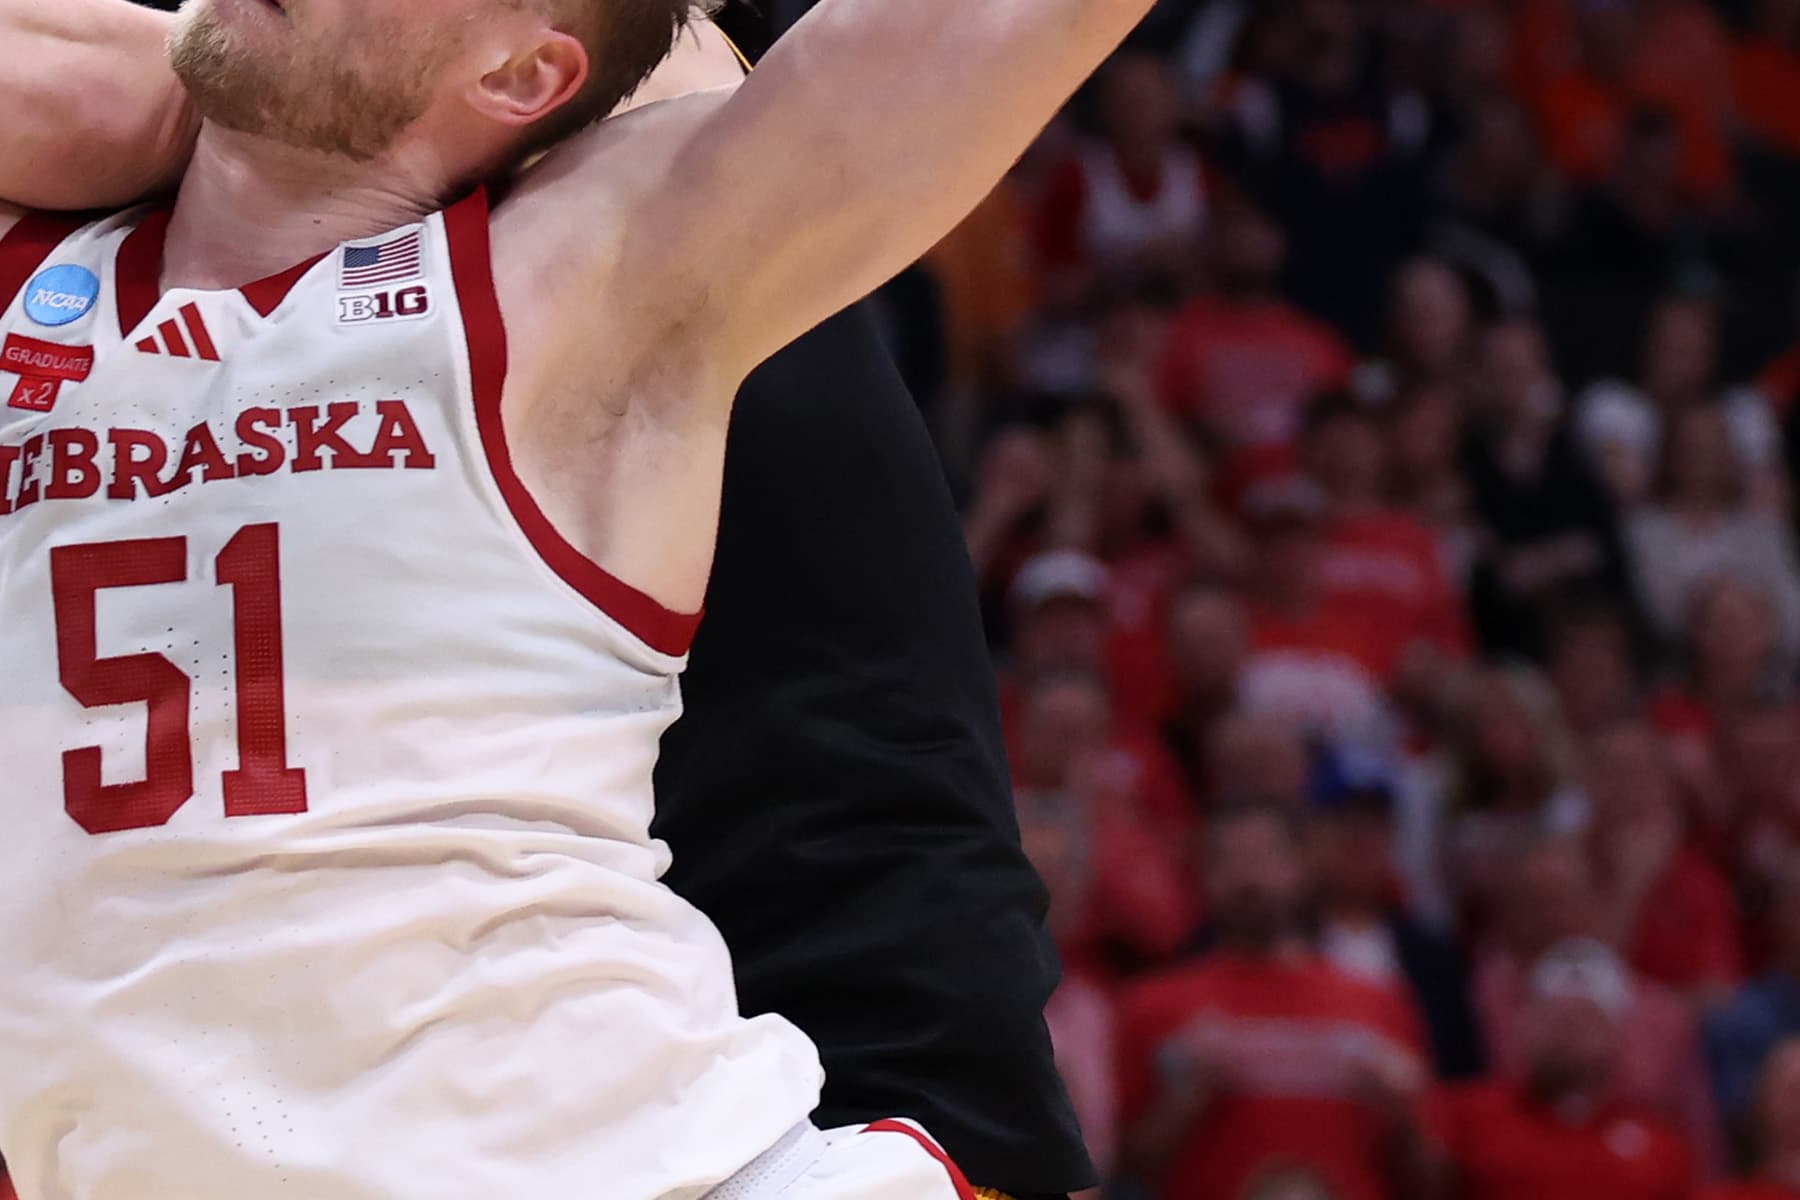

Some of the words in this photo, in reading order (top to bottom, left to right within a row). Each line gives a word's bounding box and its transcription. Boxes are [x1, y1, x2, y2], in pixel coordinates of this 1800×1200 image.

[31, 288, 90, 312] NCAA
[5, 346, 91, 372] GRADUATE
[50, 522, 309, 835] 51
